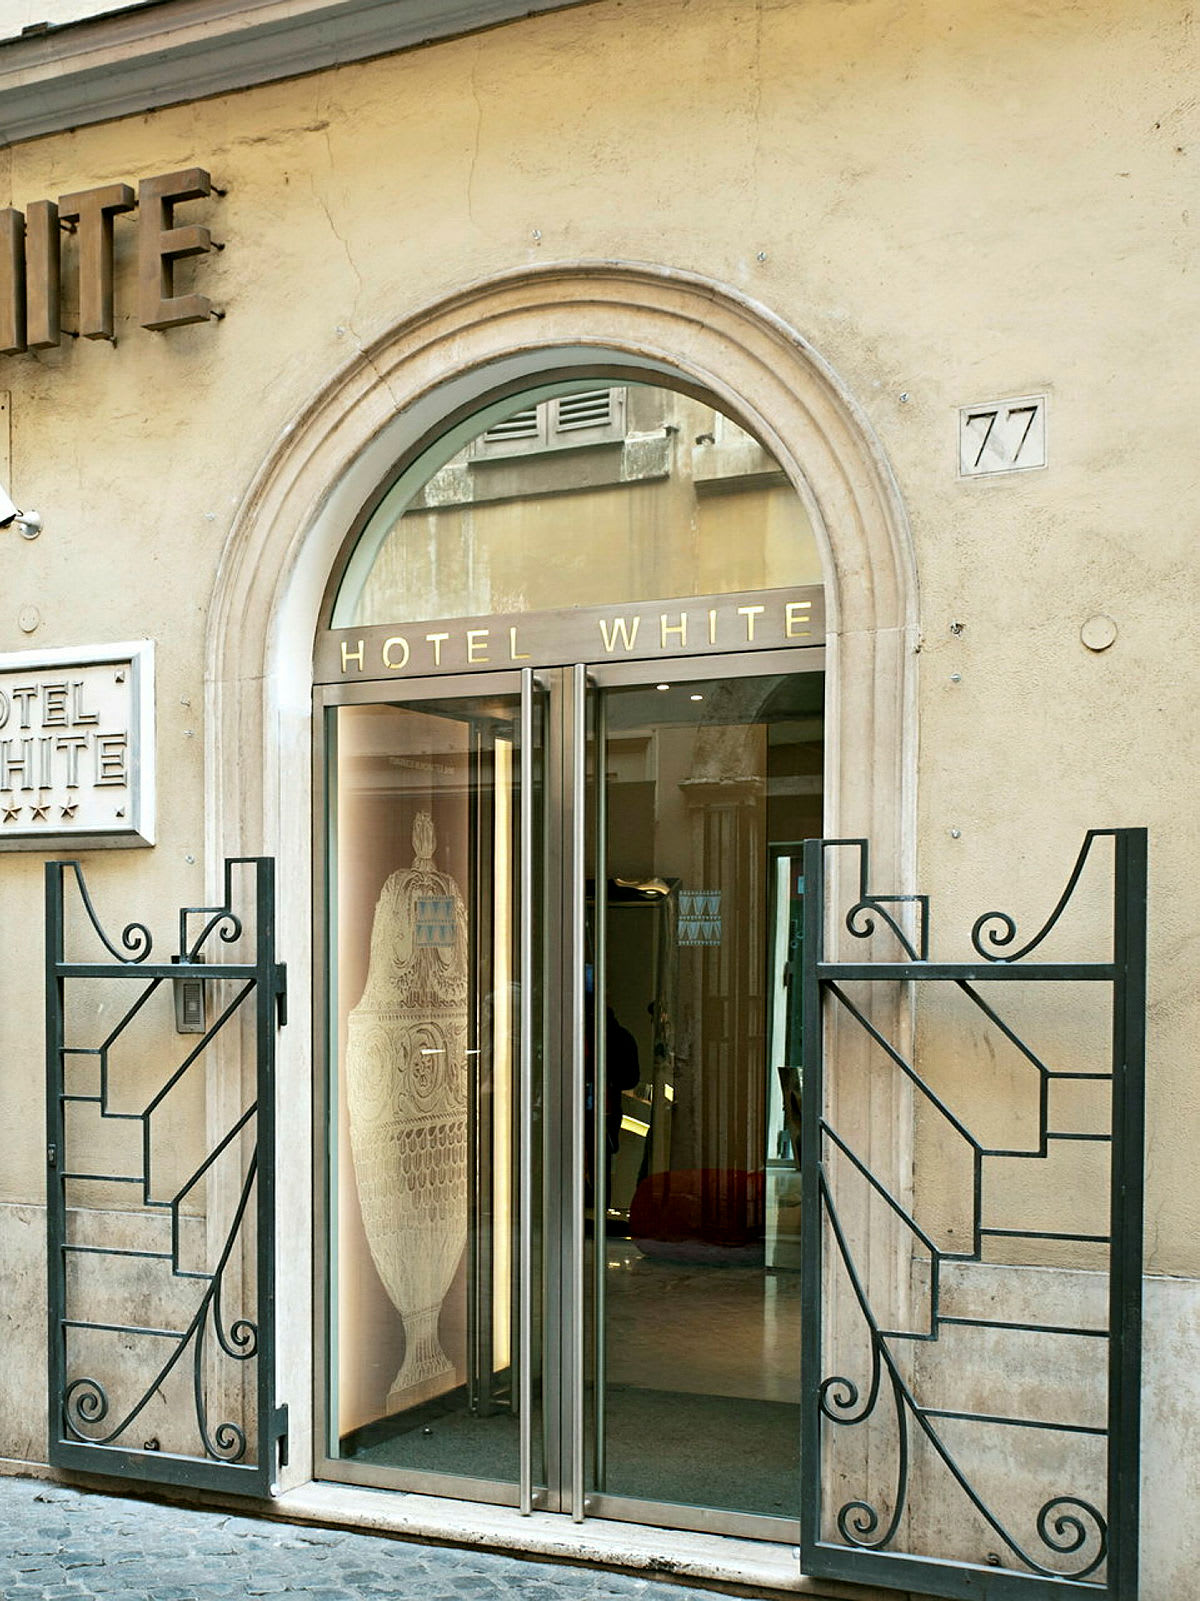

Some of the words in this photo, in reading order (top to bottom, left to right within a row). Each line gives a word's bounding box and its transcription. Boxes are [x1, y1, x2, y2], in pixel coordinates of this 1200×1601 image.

[966, 405, 1038, 467] 77
[341, 627, 532, 673] HOTEL
[599, 601, 813, 652] WHITE
